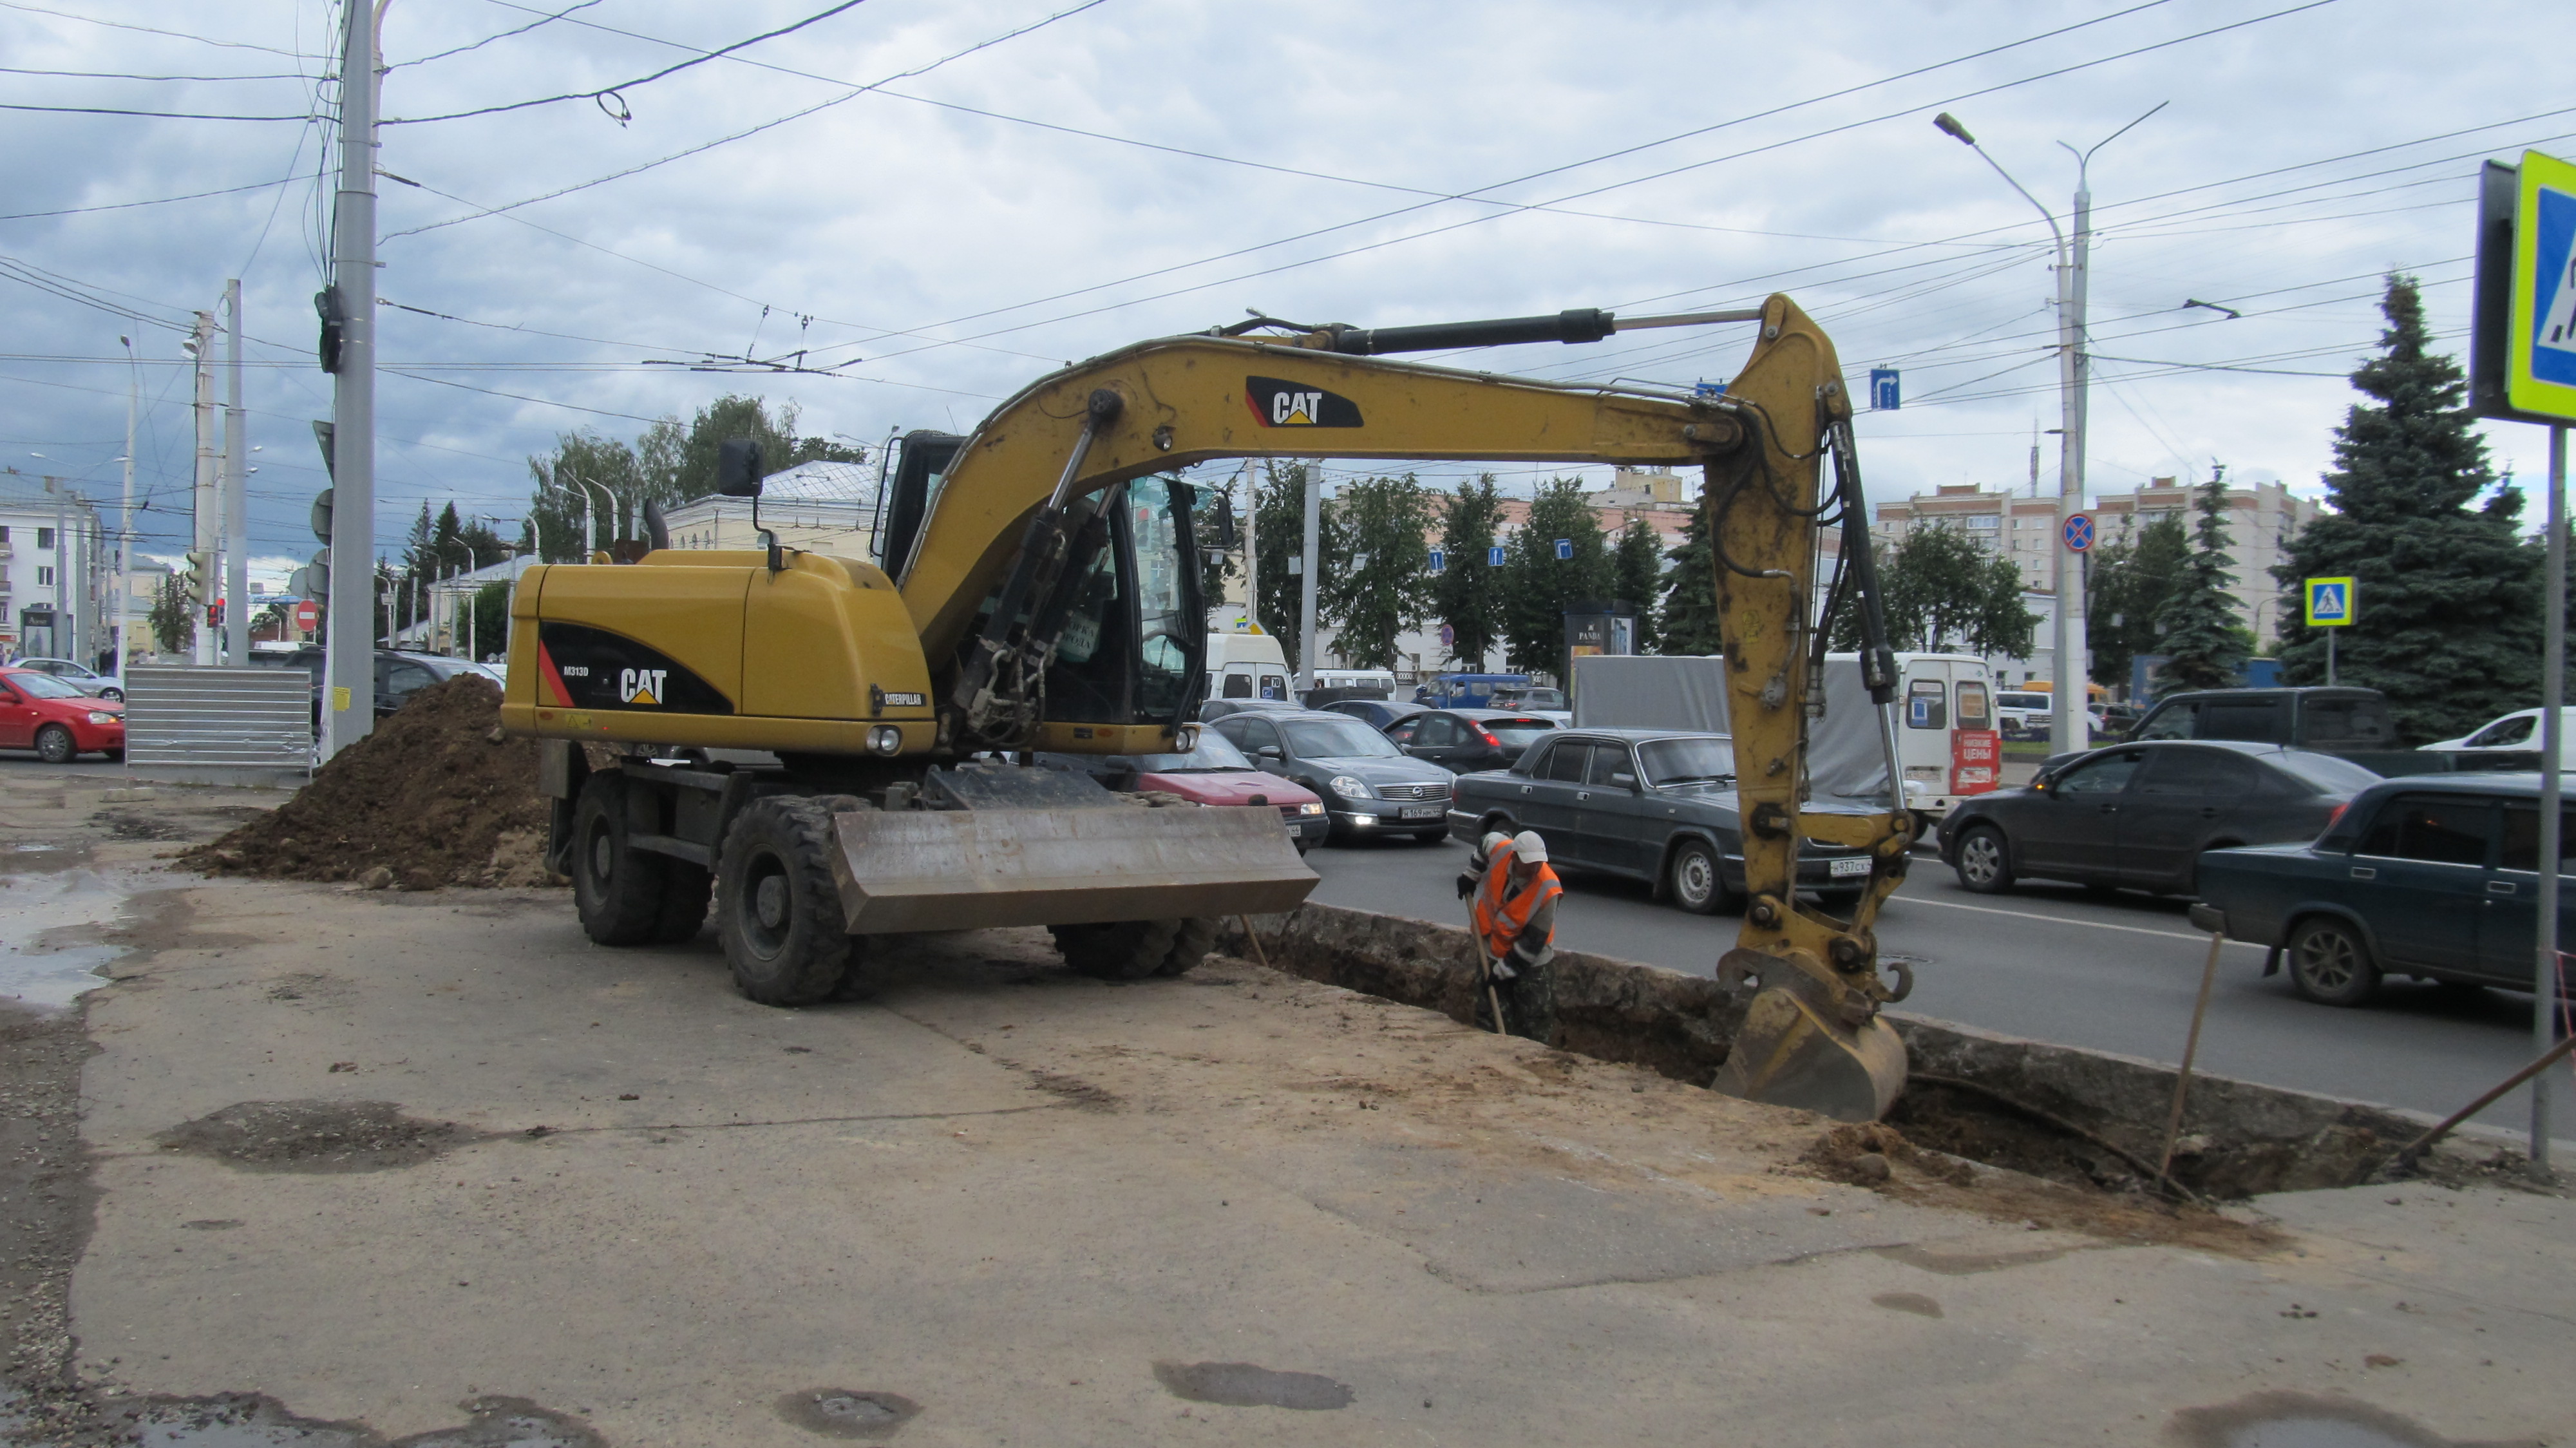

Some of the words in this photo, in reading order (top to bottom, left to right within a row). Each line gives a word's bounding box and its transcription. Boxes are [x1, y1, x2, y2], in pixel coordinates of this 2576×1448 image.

[1273, 392, 1322, 424] CAT
[1070, 622, 1094, 637] ОРКА
[1578, 632, 1600, 640] PANDA
[564, 665, 589, 676] M313D
[620, 668, 667, 705] CAT
[1272, 678, 1280, 687] 70
[885, 693, 922, 705] CATERPILLAR
[1964, 748, 1992, 761] ЦЕНЫ
